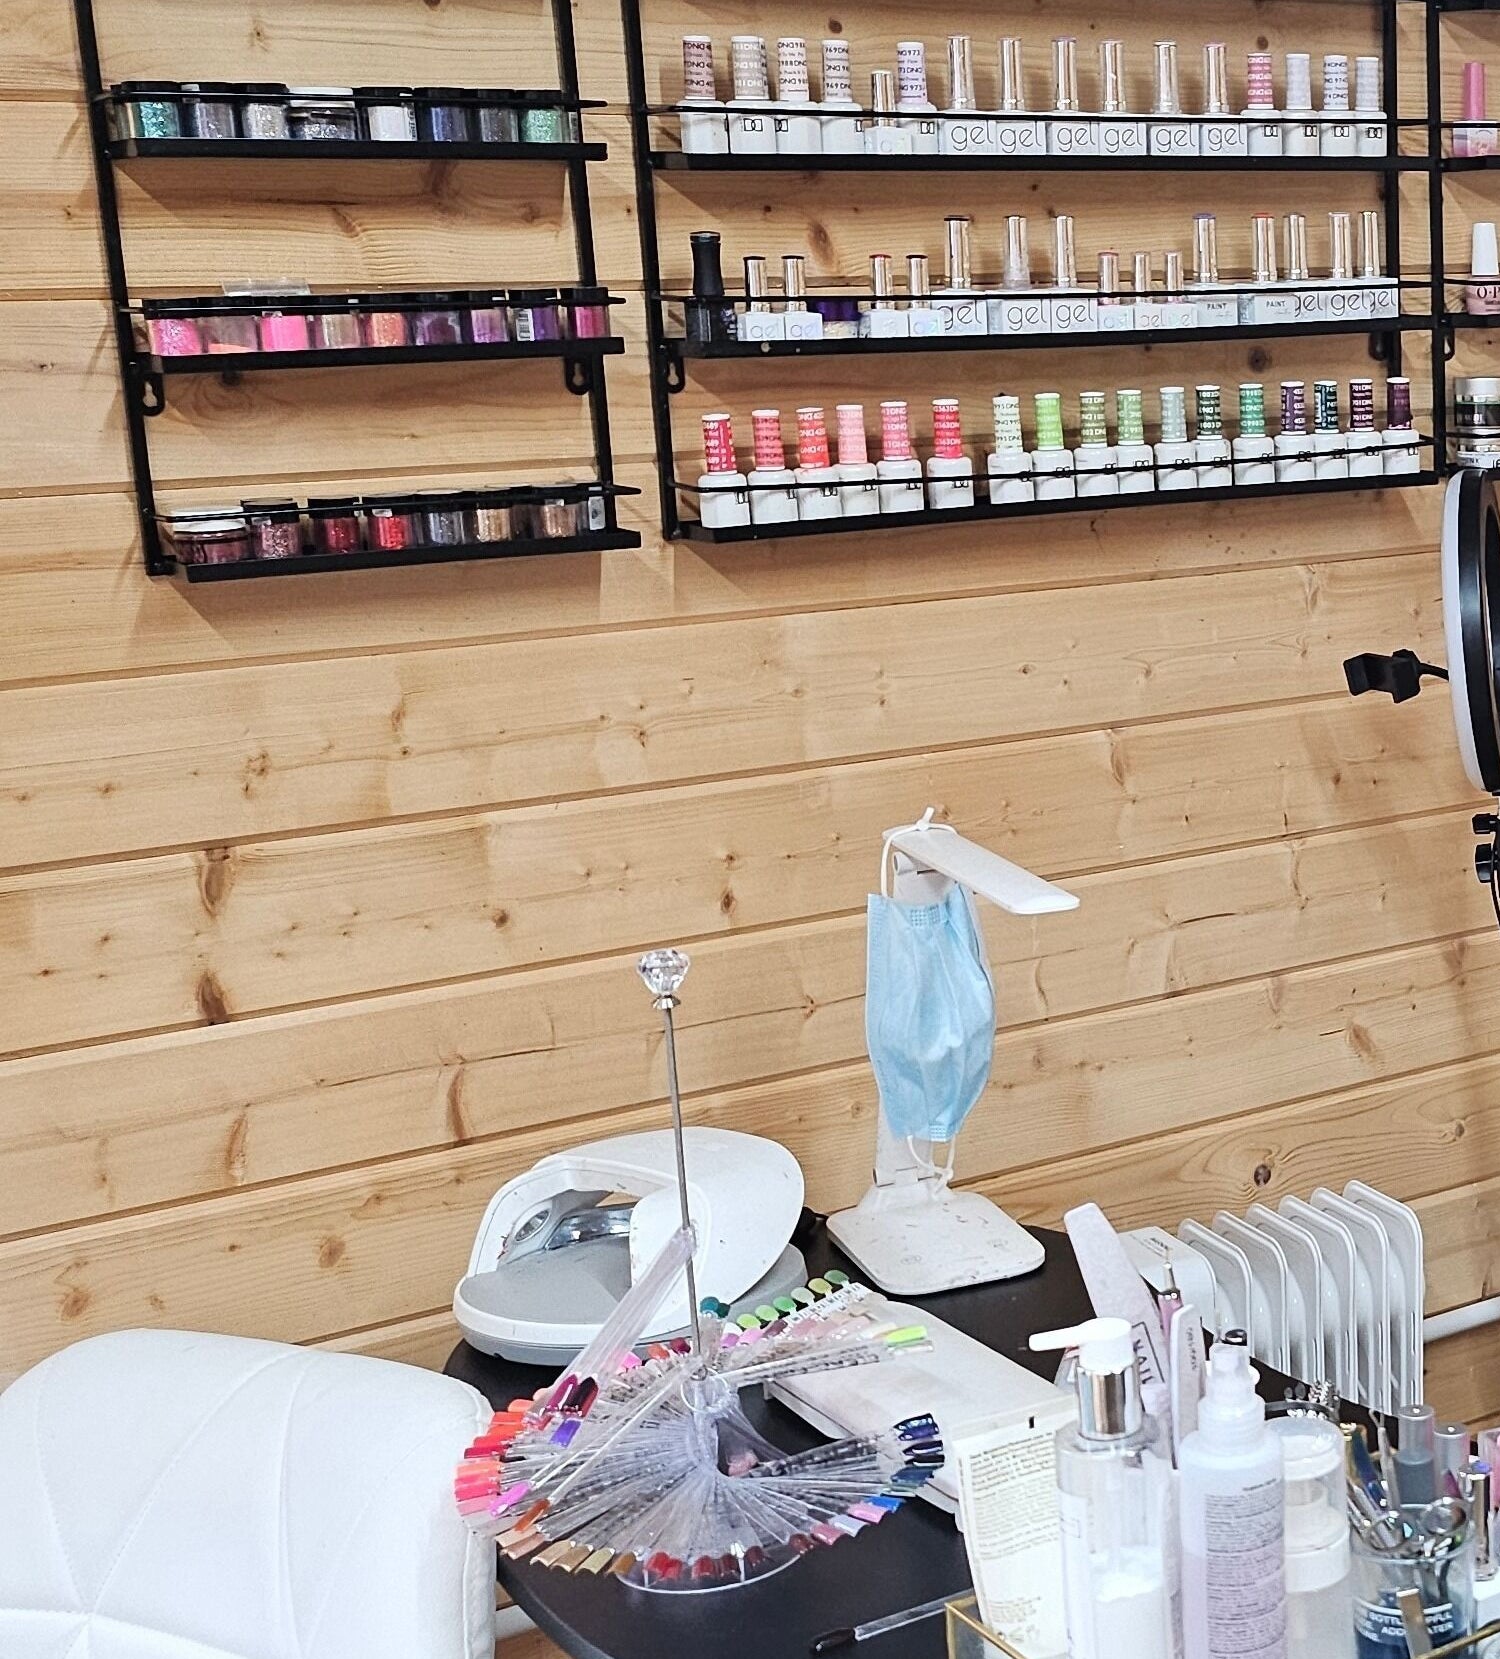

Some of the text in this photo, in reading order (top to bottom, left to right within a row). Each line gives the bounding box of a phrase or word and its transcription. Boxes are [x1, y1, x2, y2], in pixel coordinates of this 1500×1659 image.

[952, 121, 993, 151] gel
[1000, 122, 1042, 153] gel
[1058, 122, 1096, 152] gel
[1104, 123, 1142, 152] gel
[1156, 123, 1196, 152] gel
[1208, 124, 1244, 151] gel
[1007, 298, 1047, 331] gel
[1056, 298, 1094, 330] gel
[1266, 300, 1286, 308] PAINT
[1330, 291, 1368, 318] gel
